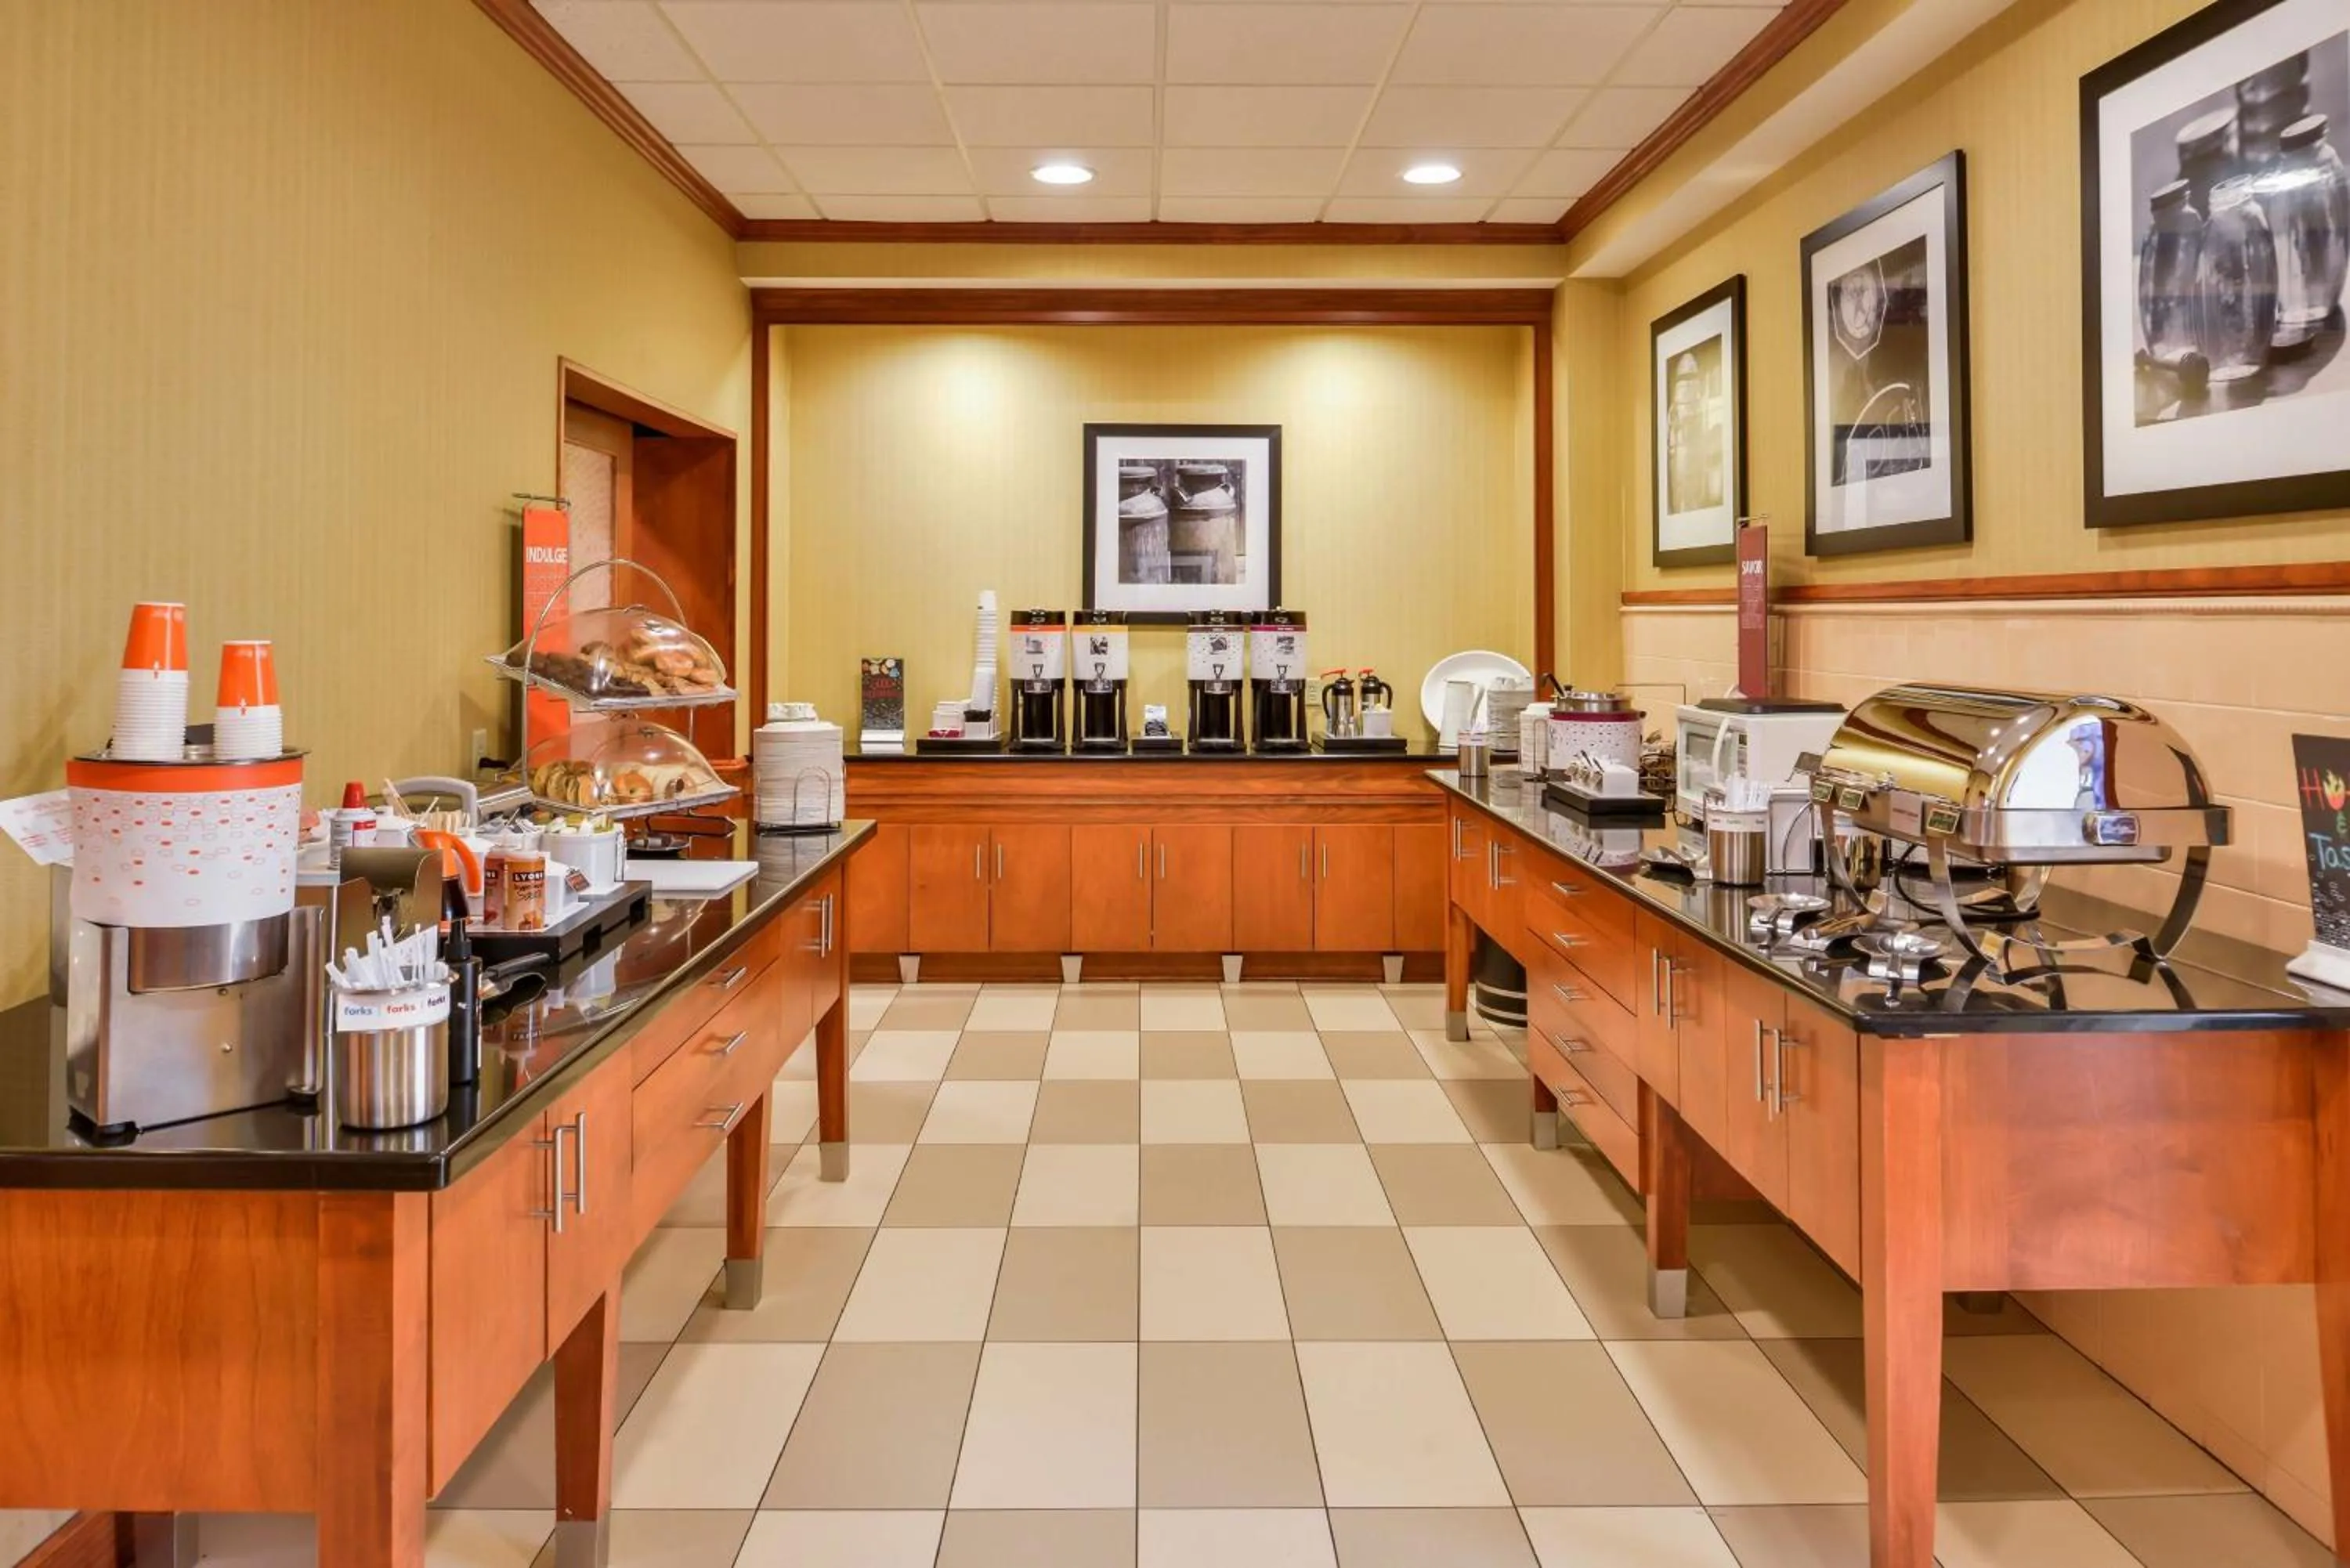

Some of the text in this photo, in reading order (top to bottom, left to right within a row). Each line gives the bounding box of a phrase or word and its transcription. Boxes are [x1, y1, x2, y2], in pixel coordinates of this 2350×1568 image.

[526, 547, 568, 564] INDULGE
[344, 1006, 373, 1016] forks
[386, 1003, 416, 1014] forks
